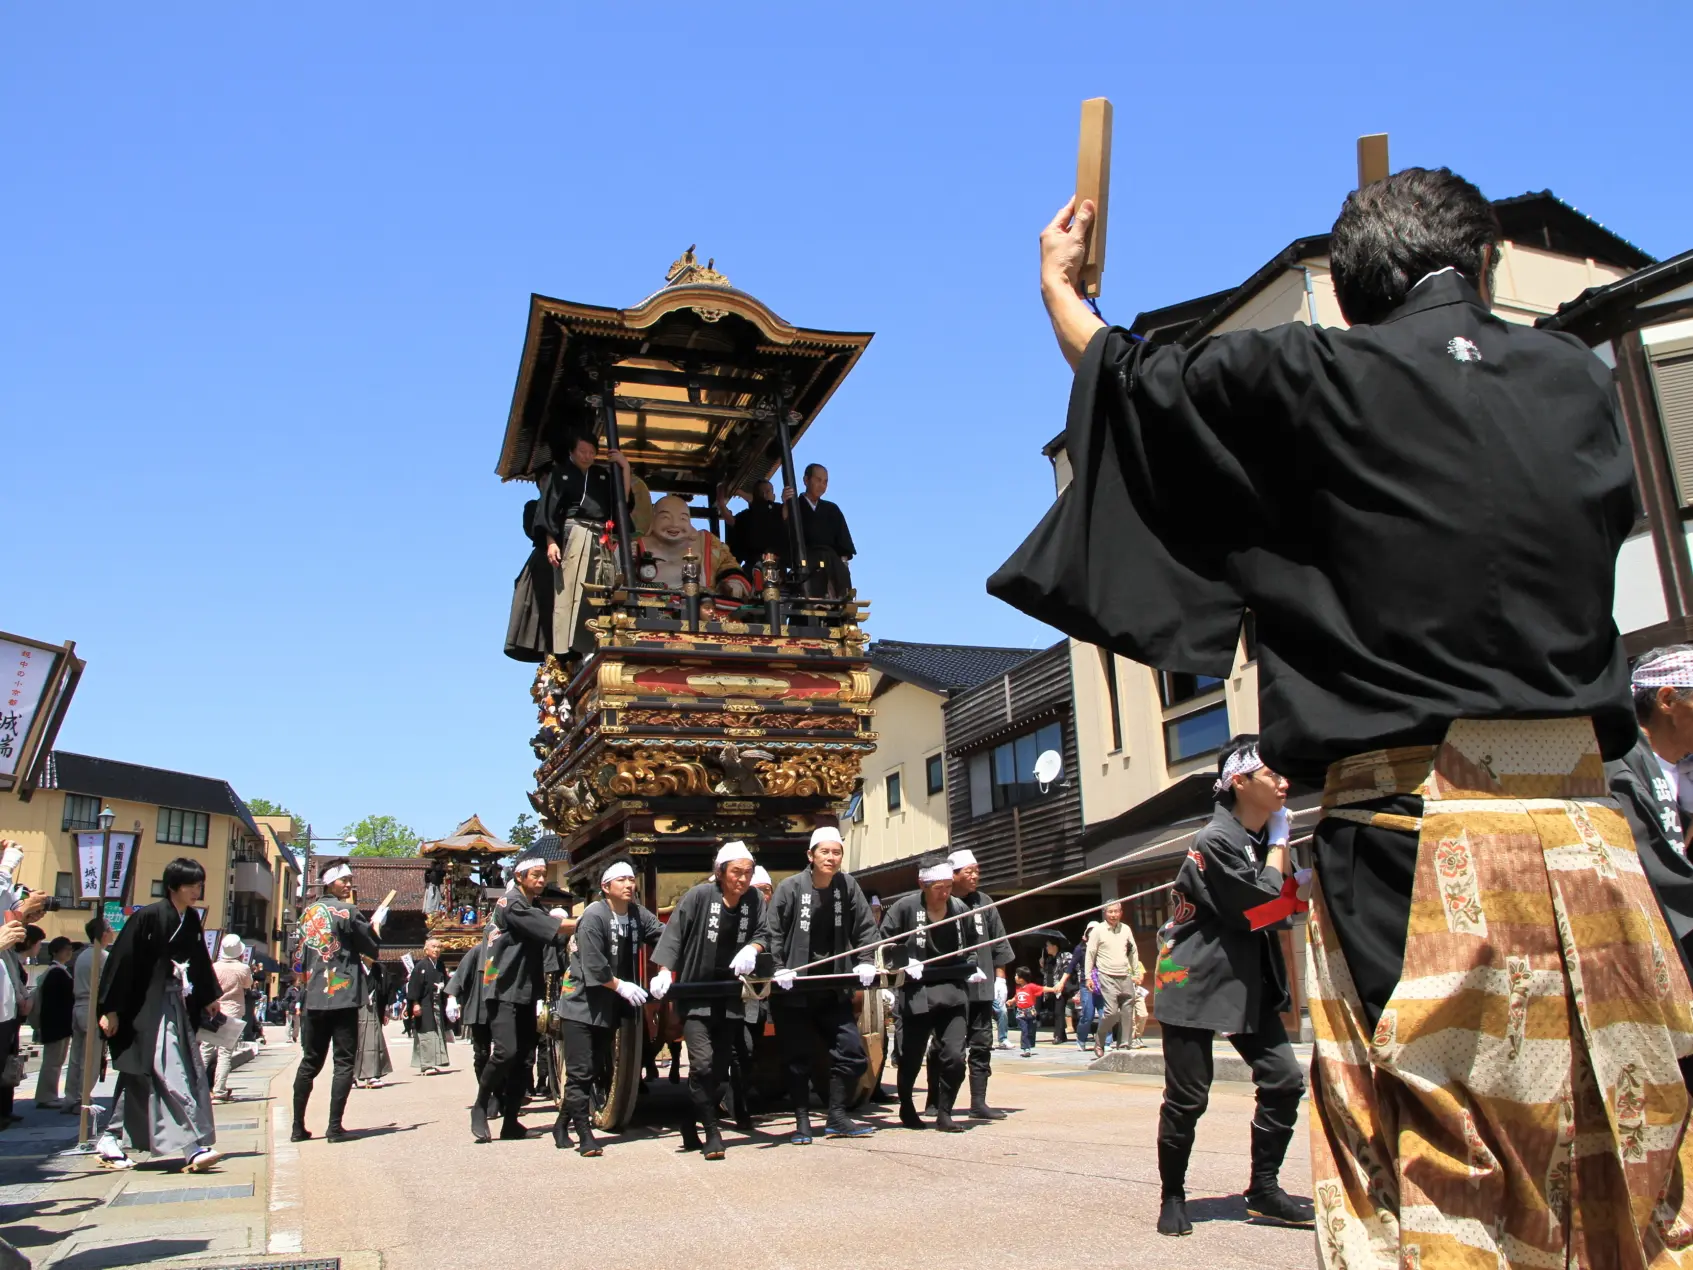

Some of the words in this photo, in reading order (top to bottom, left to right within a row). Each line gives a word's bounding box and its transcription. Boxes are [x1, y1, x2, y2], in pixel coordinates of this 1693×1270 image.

[707, 902, 721, 943] 出丸町
[799, 893, 811, 932] 出丸町
